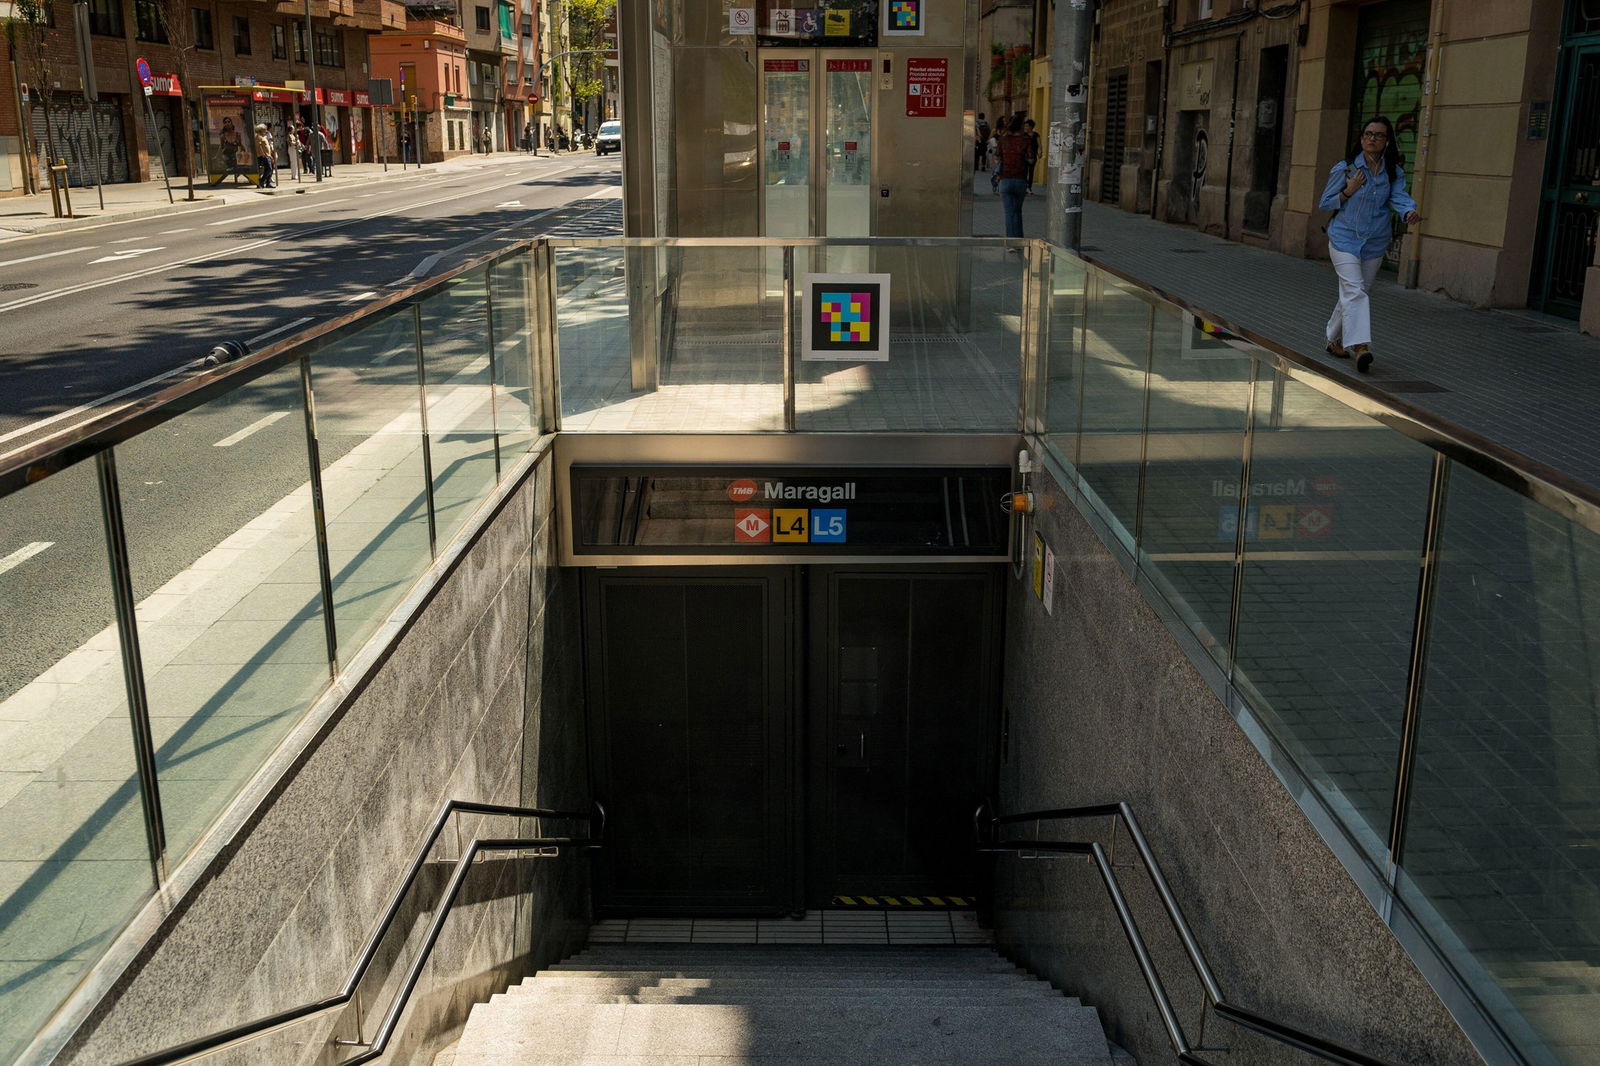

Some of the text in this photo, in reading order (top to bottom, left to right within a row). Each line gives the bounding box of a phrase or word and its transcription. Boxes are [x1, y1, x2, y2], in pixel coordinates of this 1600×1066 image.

[764, 482, 856, 503] Maragall
[746, 516, 843, 536] M L4 L5
